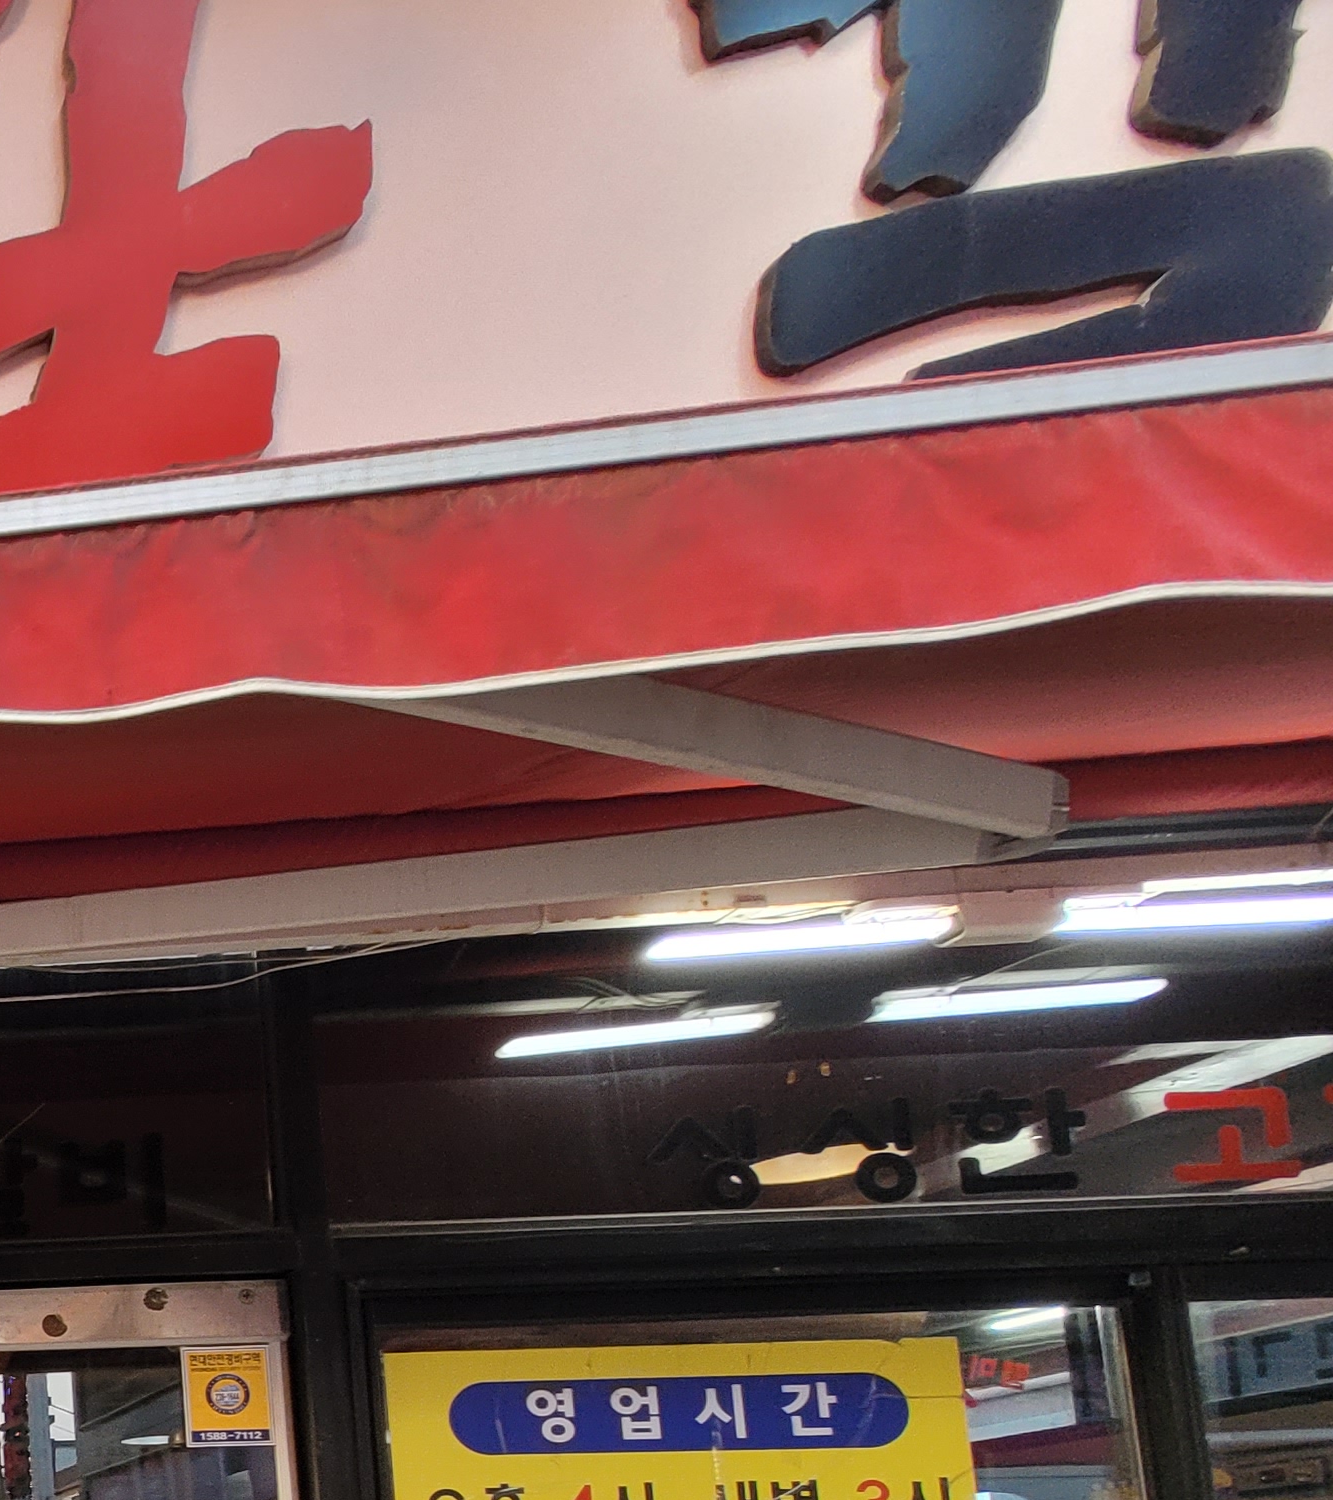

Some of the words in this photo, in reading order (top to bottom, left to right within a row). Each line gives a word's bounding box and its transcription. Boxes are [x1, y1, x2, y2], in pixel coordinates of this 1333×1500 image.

[645, 1086, 1086, 1209] 싱싱한
[199, 1430, 263, 1441] 1588-7112
[526, 1380, 837, 1444] 영업시간
